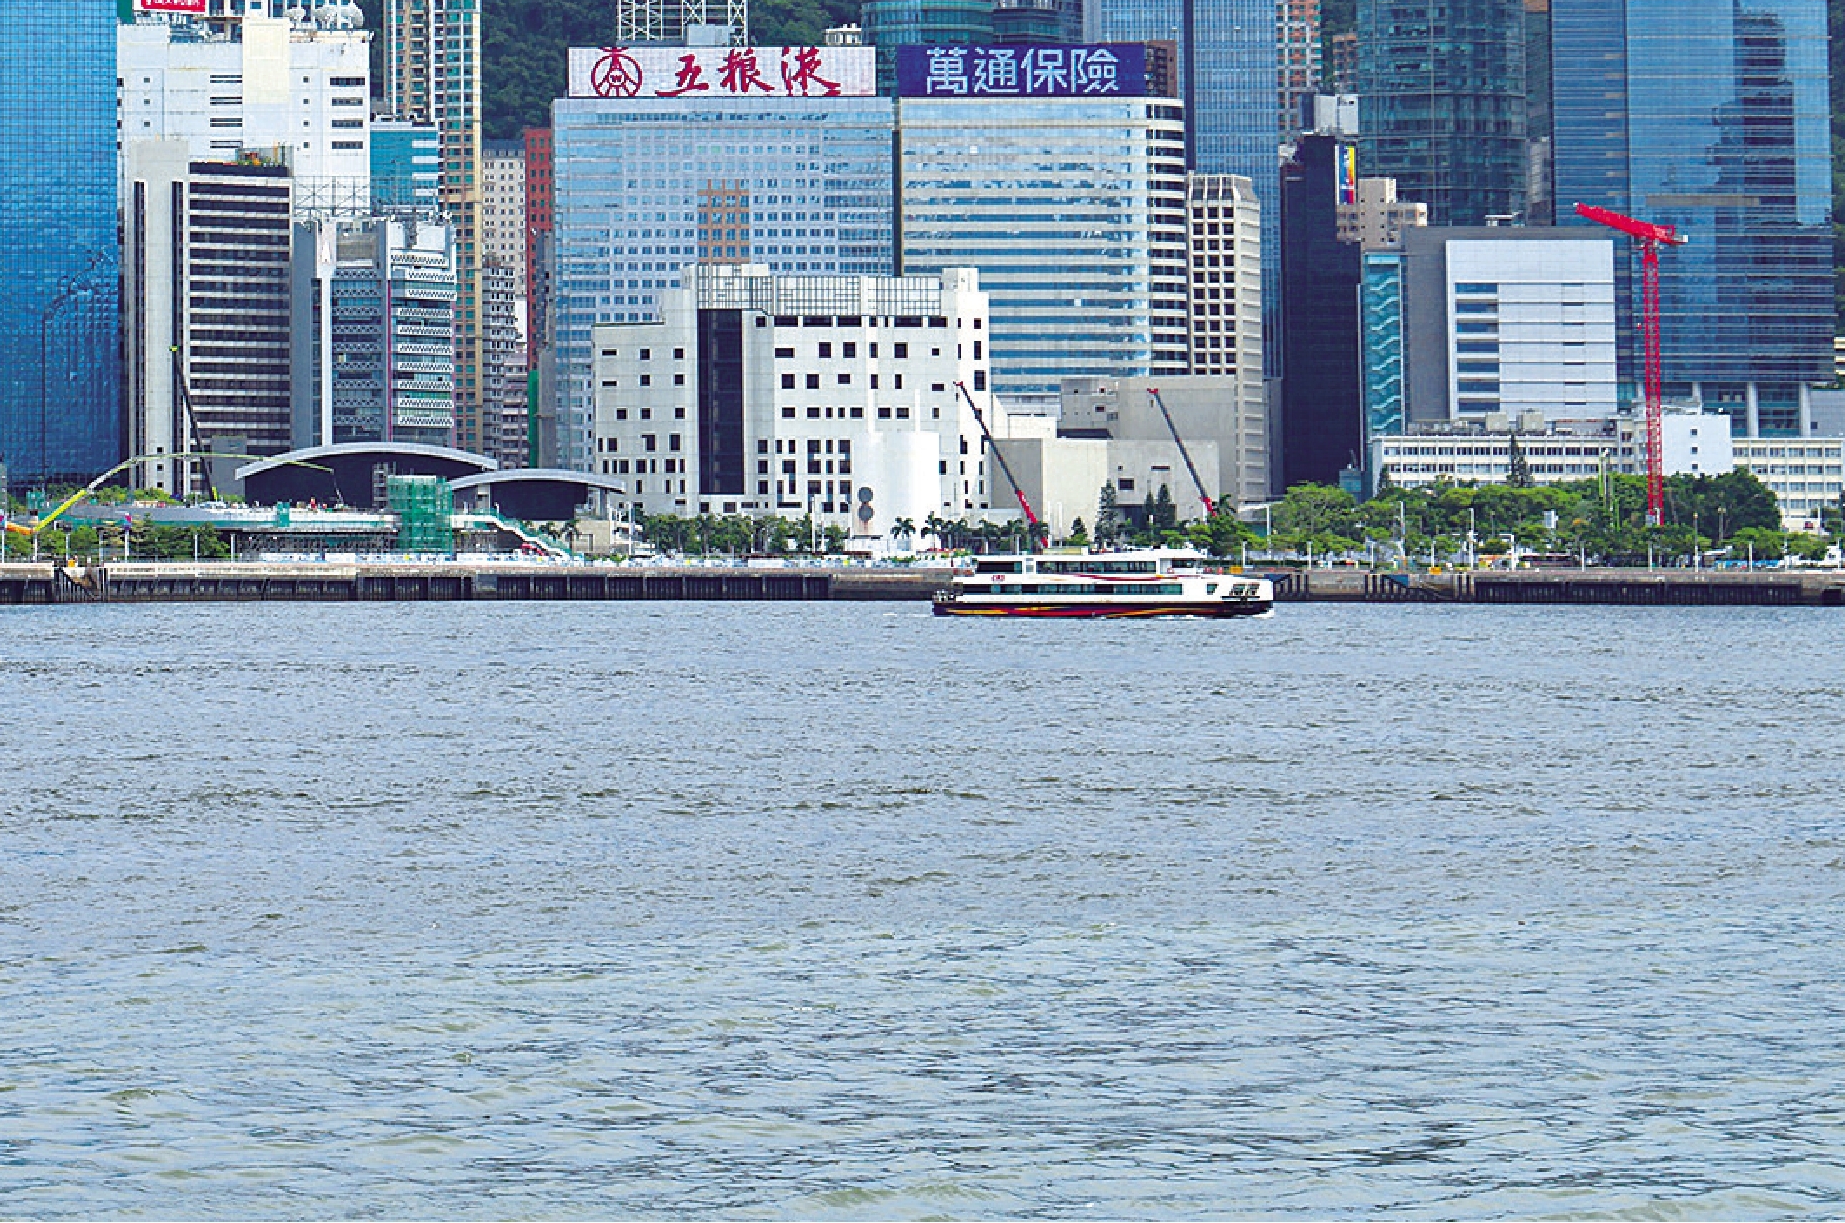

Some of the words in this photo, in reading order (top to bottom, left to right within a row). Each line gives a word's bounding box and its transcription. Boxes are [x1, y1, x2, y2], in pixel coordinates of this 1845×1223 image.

[655, 46, 842, 96] 五粮液
[926, 46, 1120, 95] 萬通保險
